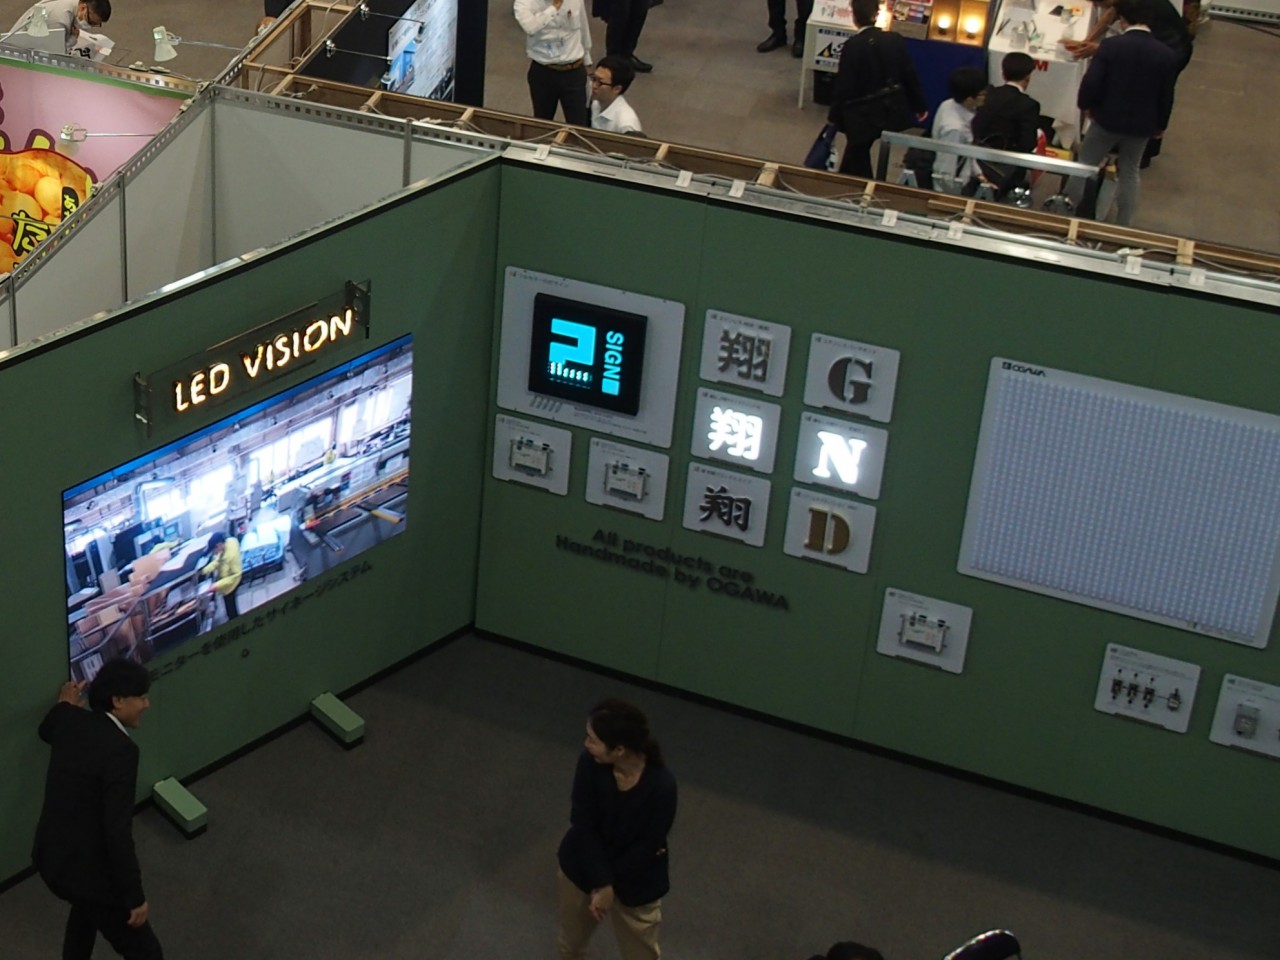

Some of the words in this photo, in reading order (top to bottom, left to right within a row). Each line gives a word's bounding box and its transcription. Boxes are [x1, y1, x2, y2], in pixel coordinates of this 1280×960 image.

[174, 362, 231, 412] LED
[241, 306, 353, 379] VISION
[602, 330, 625, 380] SIGN
[718, 328, 772, 383] 翔
[827, 355, 874, 405] G
[707, 406, 764, 461] 翔
[811, 430, 868, 485] N
[698, 484, 752, 532] 翔
[803, 507, 851, 555] D
[555, 534, 670, 579] Handmade
[673, 566, 701, 590] by
[706, 576, 790, 612] OGAWA
[591, 528, 618, 548] All
[622, 538, 713, 575] products
[717, 563, 755, 584] are
